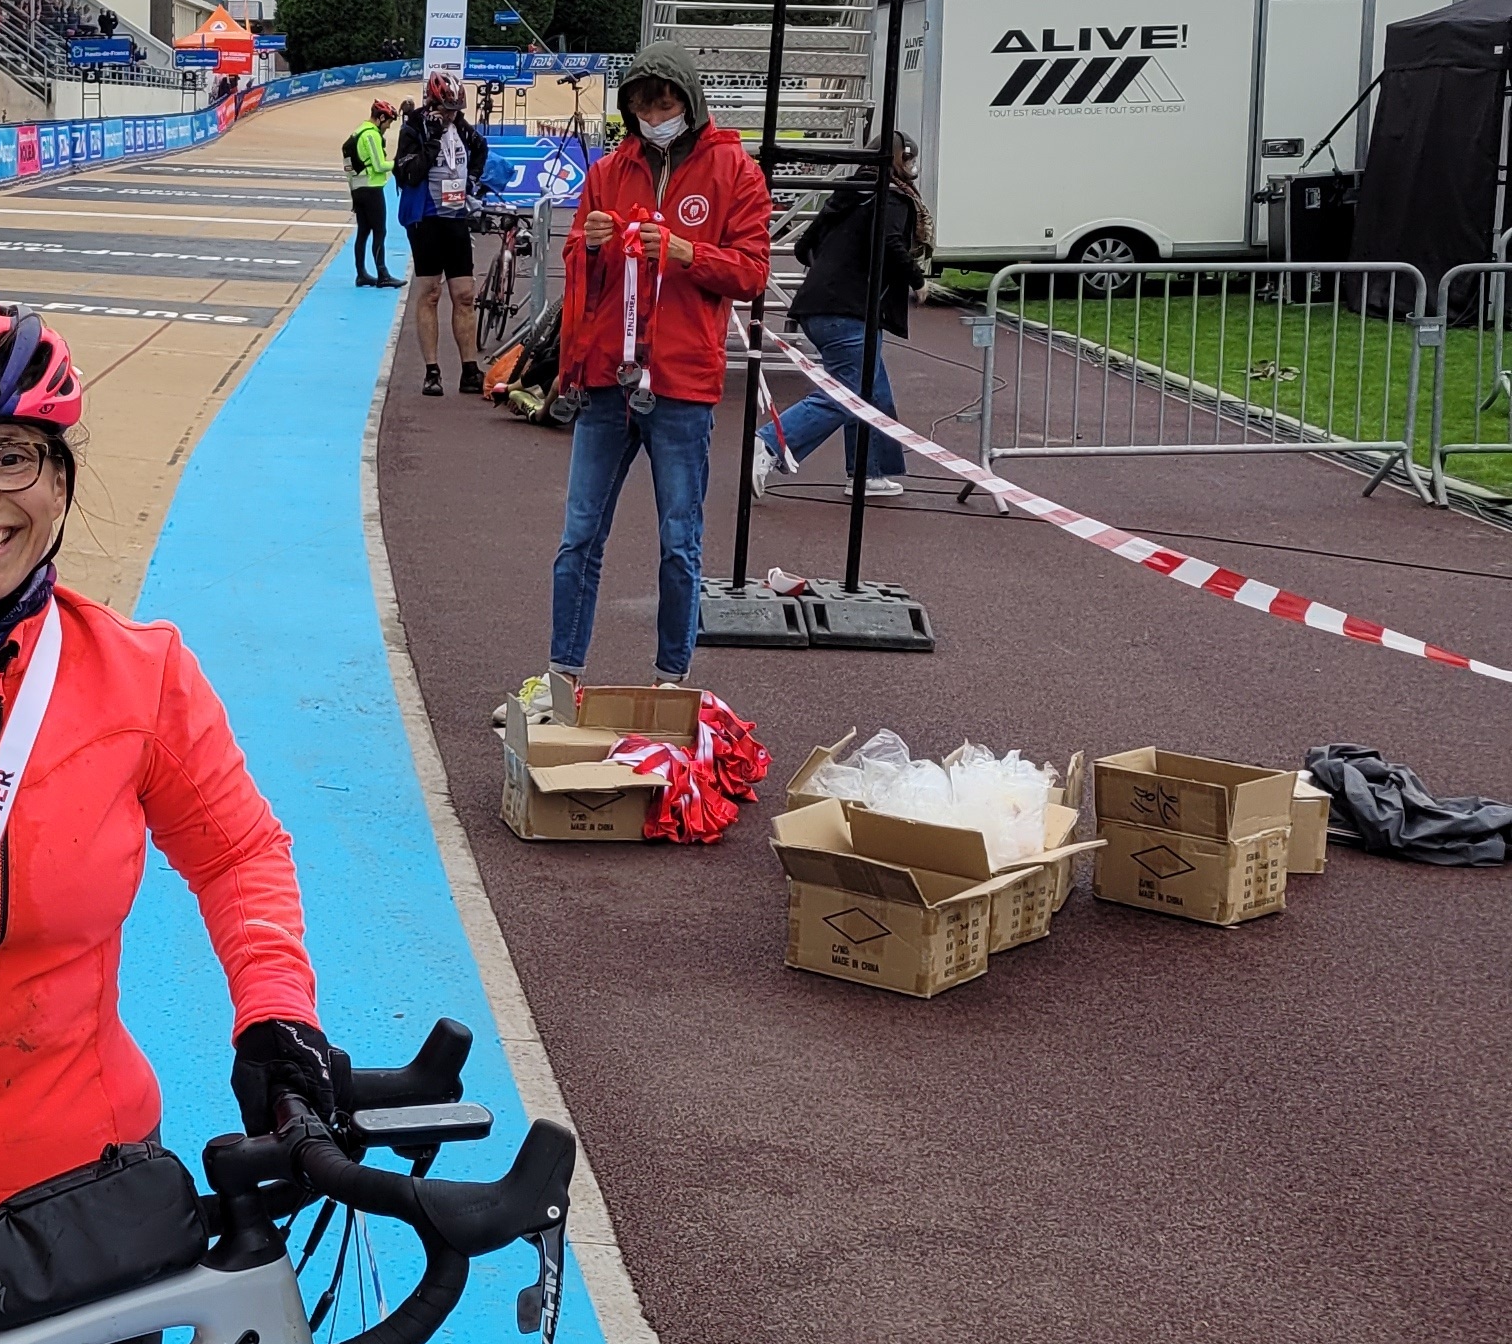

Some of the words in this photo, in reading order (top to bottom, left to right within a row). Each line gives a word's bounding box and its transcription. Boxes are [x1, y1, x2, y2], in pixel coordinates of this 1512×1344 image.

[430, 38, 451, 47] FDJ
[990, 24, 1188, 54] ALIVE!
[1058, 107, 1083, 116] POUR
[1138, 888, 1155, 900] MADE
[1157, 892, 1164, 902] IN
[1166, 894, 1184, 906] CHINA
[831, 954, 850, 968] MADE
[852, 958, 859, 969] IN
[861, 960, 880, 974] CHINA
